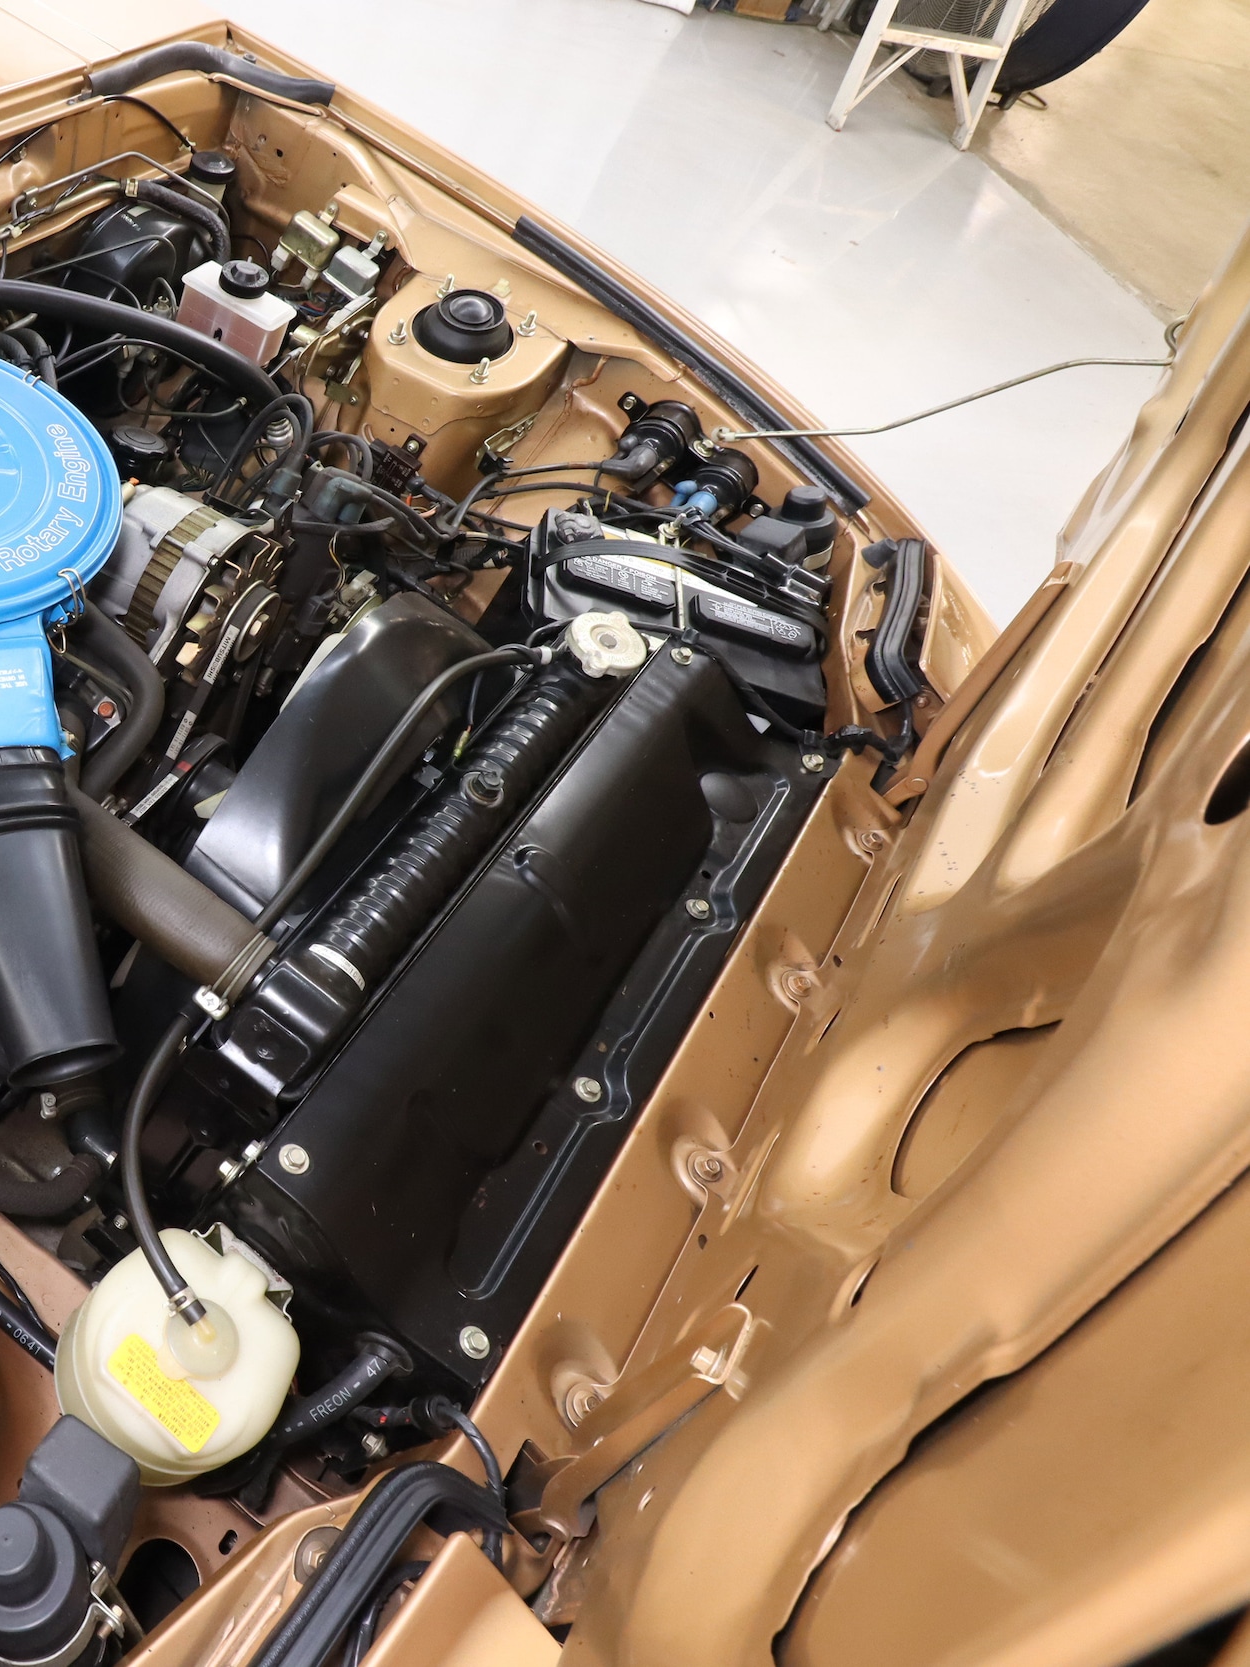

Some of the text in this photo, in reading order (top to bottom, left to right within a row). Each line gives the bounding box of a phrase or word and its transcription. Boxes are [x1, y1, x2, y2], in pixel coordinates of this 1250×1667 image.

[46, 423, 91, 502] Engine
[591, 556, 622, 570] DANGER
[628, 568, 656, 580] POISON
[11, 1326, 42, 1356] 0641
[307, 1386, 353, 1422] FREON
